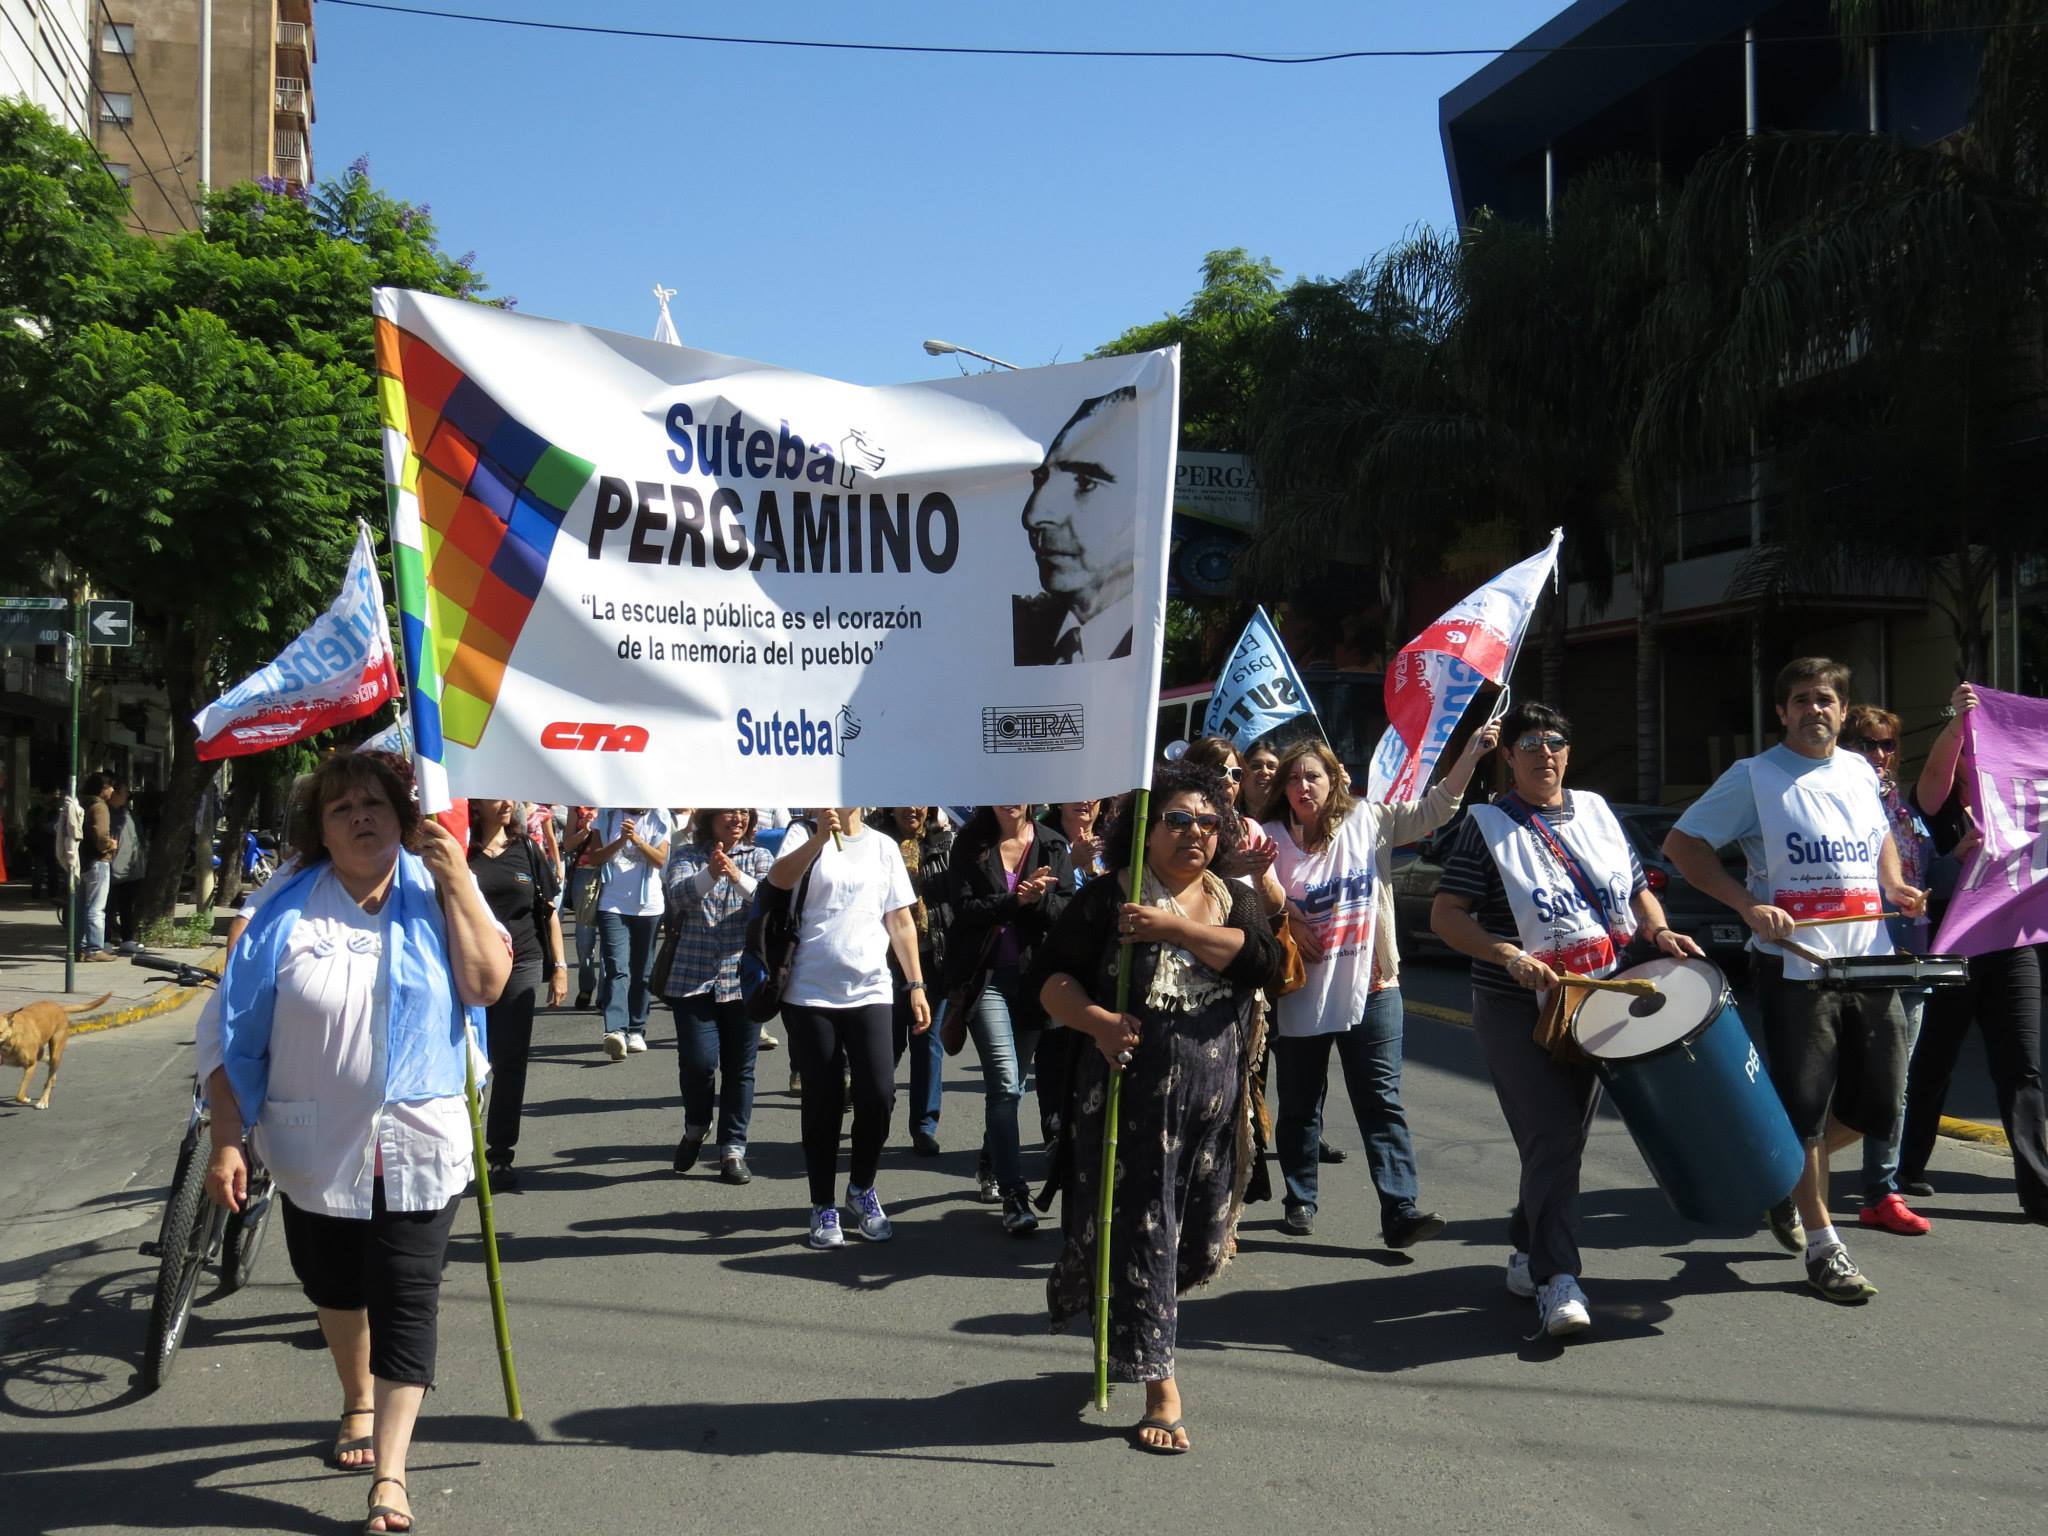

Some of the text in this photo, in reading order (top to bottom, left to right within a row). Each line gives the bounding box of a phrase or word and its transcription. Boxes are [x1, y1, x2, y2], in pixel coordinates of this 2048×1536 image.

[665, 402, 836, 487] Suteba
[587, 475, 960, 574] PERGAMINO
[581, 594, 923, 631] “La escuela pública es el corazón
[39, 630, 60, 641] 400
[617, 634, 885, 671] de la memoria del pueblo”
[540, 721, 650, 753] CTA
[736, 707, 834, 757] Suteba
[997, 713, 1080, 739] CTERA
[1786, 832, 1870, 865] Suteba
